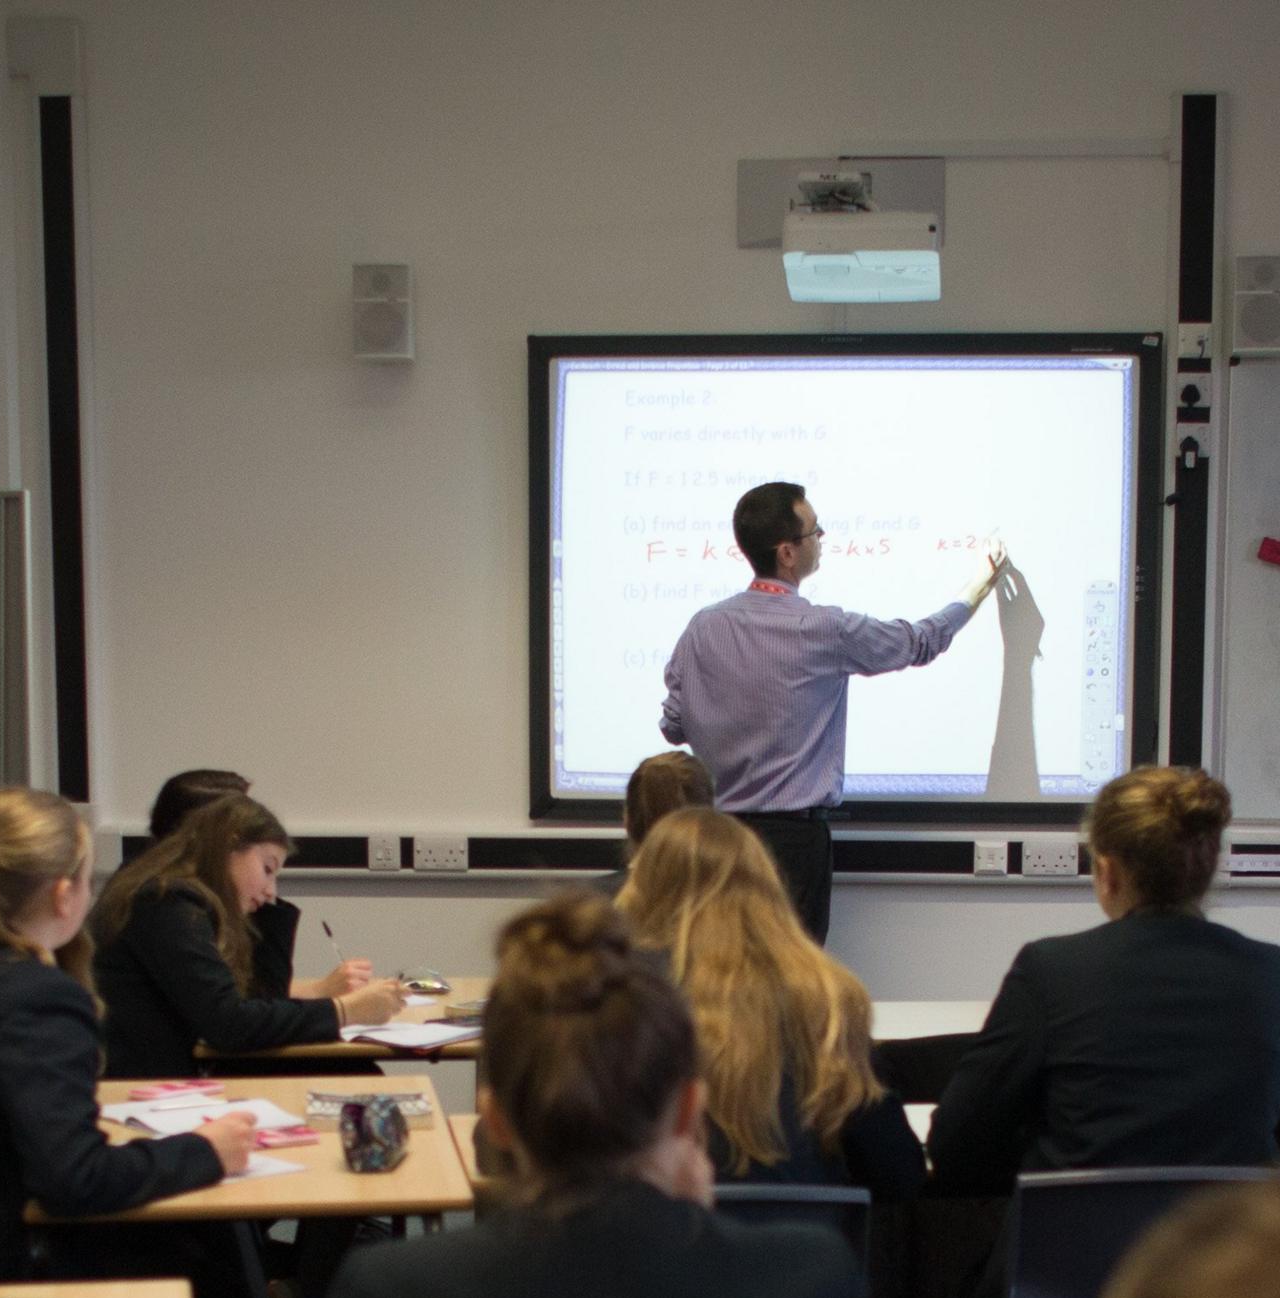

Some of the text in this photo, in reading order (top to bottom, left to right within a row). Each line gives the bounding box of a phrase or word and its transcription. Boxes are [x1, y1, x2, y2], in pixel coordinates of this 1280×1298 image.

[624, 388, 696, 409] Example
[624, 424, 634, 441] F
[640, 425, 691, 441] varies
[697, 424, 765, 444] directly
[771, 424, 809, 441] with
[624, 470, 641, 487] If
[648, 471, 658, 487] F
[726, 471, 768, 487] when
[807, 471, 818, 487] 5
[623, 515, 646, 535] (a)
[654, 515, 687, 531] find
[692, 519, 711, 531] an
[855, 515, 865, 530] F
[872, 515, 903, 530] and
[909, 515, 921, 530] G
[646, 540, 667, 562] F
[623, 583, 648, 602] (b)
[654, 583, 688, 599] find
[694, 583, 704, 600] F
[623, 648, 646, 670] (c)
